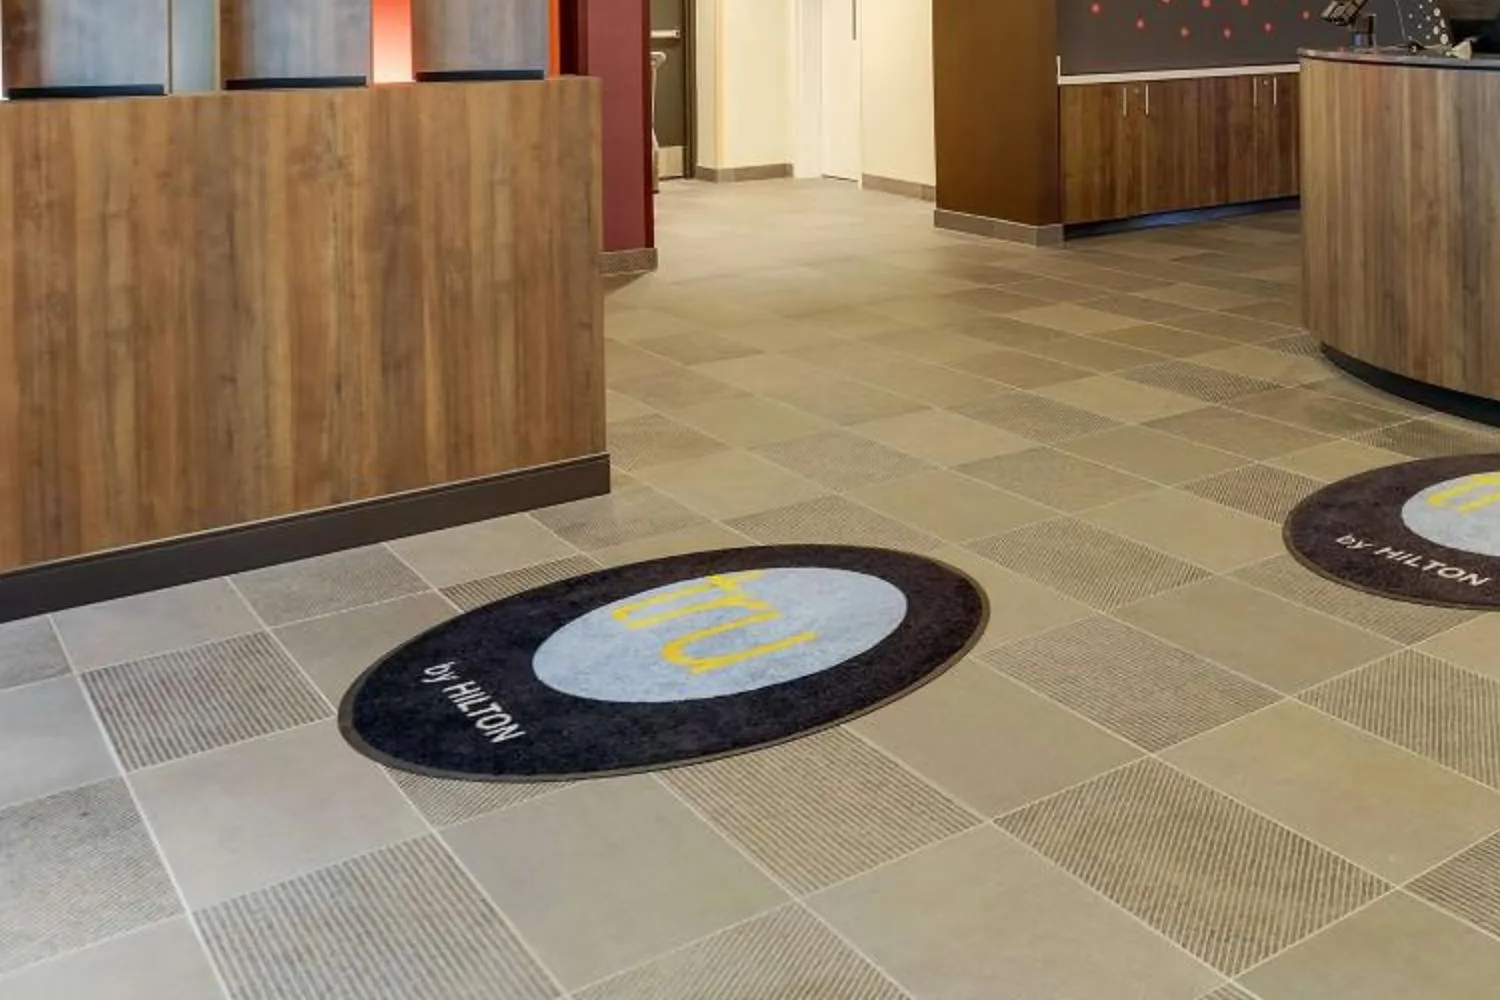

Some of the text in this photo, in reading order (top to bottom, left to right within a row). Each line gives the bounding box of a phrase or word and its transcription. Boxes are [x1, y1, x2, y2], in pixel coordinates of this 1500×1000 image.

[1335, 533, 1494, 588] by HILTON
[610, 571, 819, 675] tru
[421, 661, 526, 743] by HILTON
